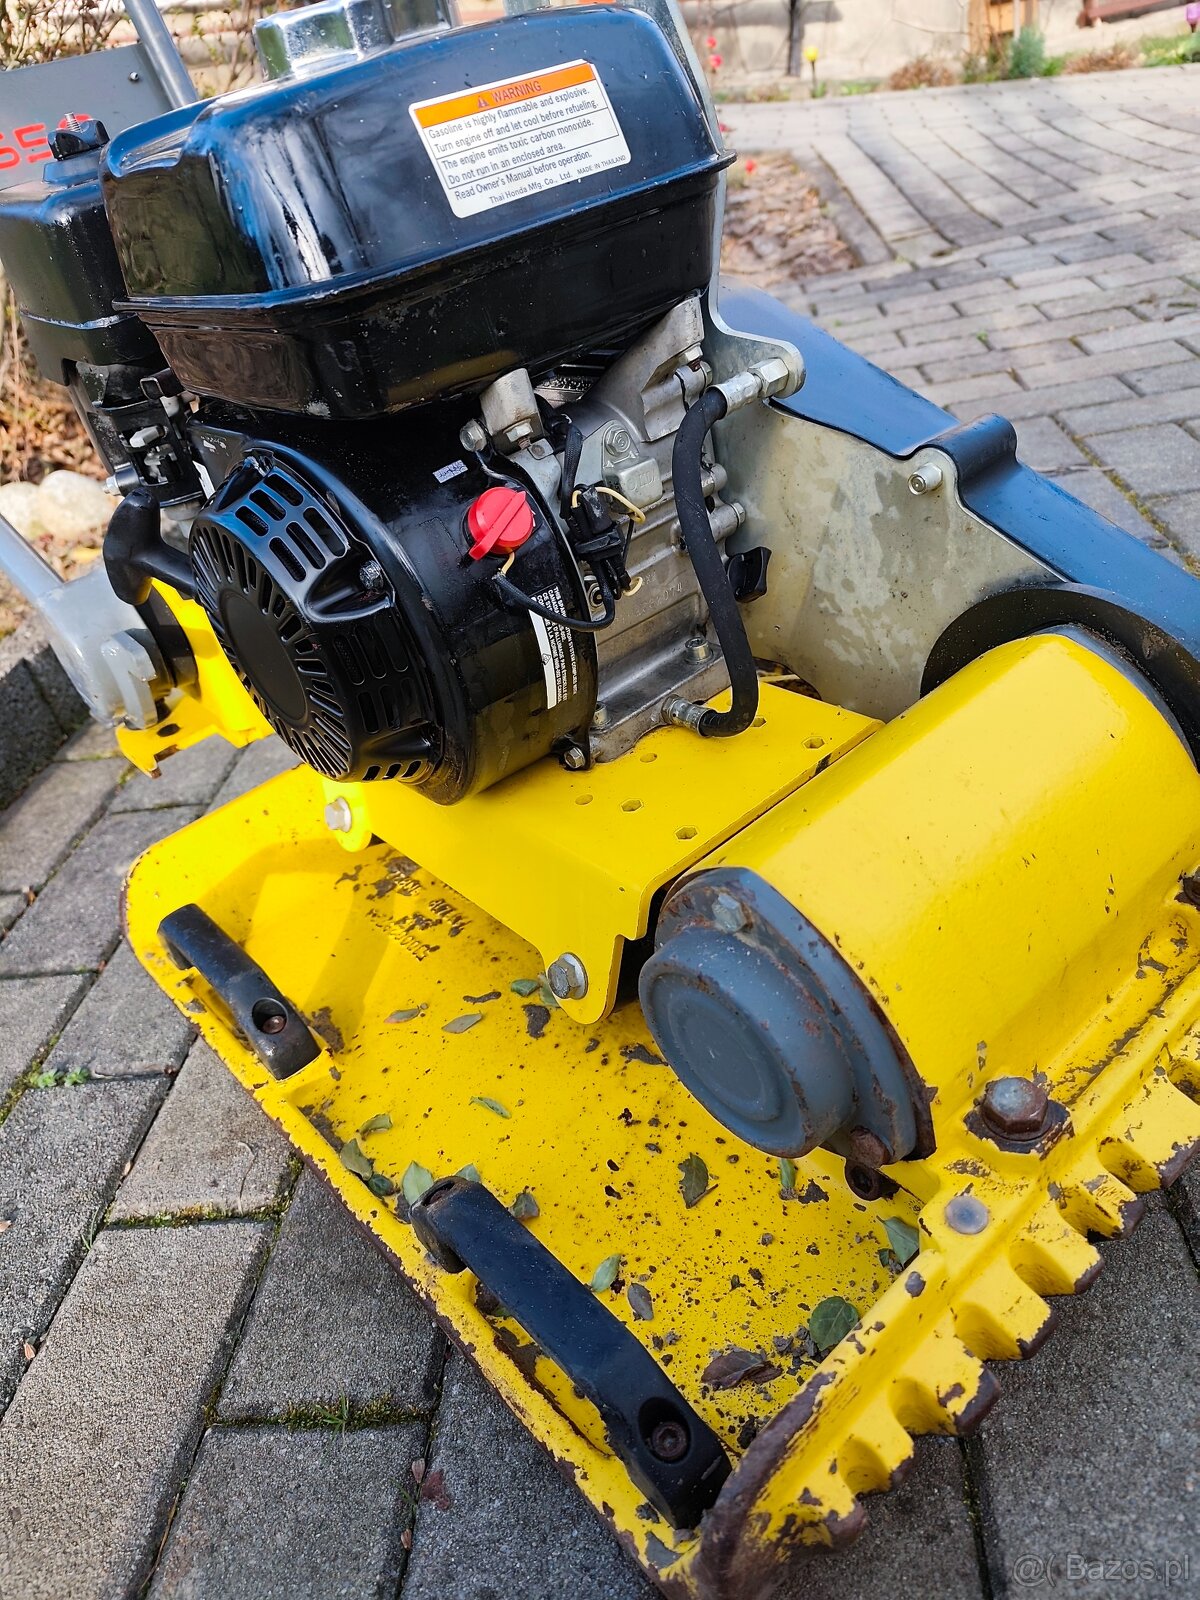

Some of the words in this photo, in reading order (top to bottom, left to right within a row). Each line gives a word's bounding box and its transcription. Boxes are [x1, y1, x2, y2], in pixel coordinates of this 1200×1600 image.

[428, 124, 463, 139] Gasoline
[472, 113, 496, 126] highly
[497, 101, 538, 119] flammable
[539, 96, 554, 107] and
[555, 88, 589, 103] explosive.
[491, 81, 542, 102] WARNING
[434, 142, 454, 153] Turn
[455, 134, 481, 147] engine
[483, 128, 494, 139] off
[496, 123, 511, 135] and
[510, 121, 523, 130] let
[523, 115, 540, 127] cool
[539, 110, 564, 122] before
[565, 100, 598, 115] refueling.
[441, 160, 458, 170] The
[460, 151, 486, 165] engine
[488, 144, 509, 156] emits
[509, 137, 529, 149] toxic
[530, 130, 556, 143] carbon
[557, 118, 594, 135] monoxide.
[448, 175, 460, 185] Do
[461, 169, 476, 180] not
[476, 166, 490, 176] run
[490, 162, 500, 171] in
[500, 159, 511, 168] an
[512, 147, 545, 164] enclosed
[546, 143, 565, 154] area.
[454, 186, 475, 200] Read
[476, 177, 506, 193] Owner's
[505, 167, 533, 183] Manual
[533, 162, 557, 174] before
[558, 151, 592, 167] operation.
[489, 193, 505, 203] Thai
[505, 187, 528, 198] Honda
[528, 182, 543, 191] Mfg.
[559, 171, 573, 181] Ltd.
[577, 165, 593, 174] MADE
[601, 155, 626, 166] THAILAND
